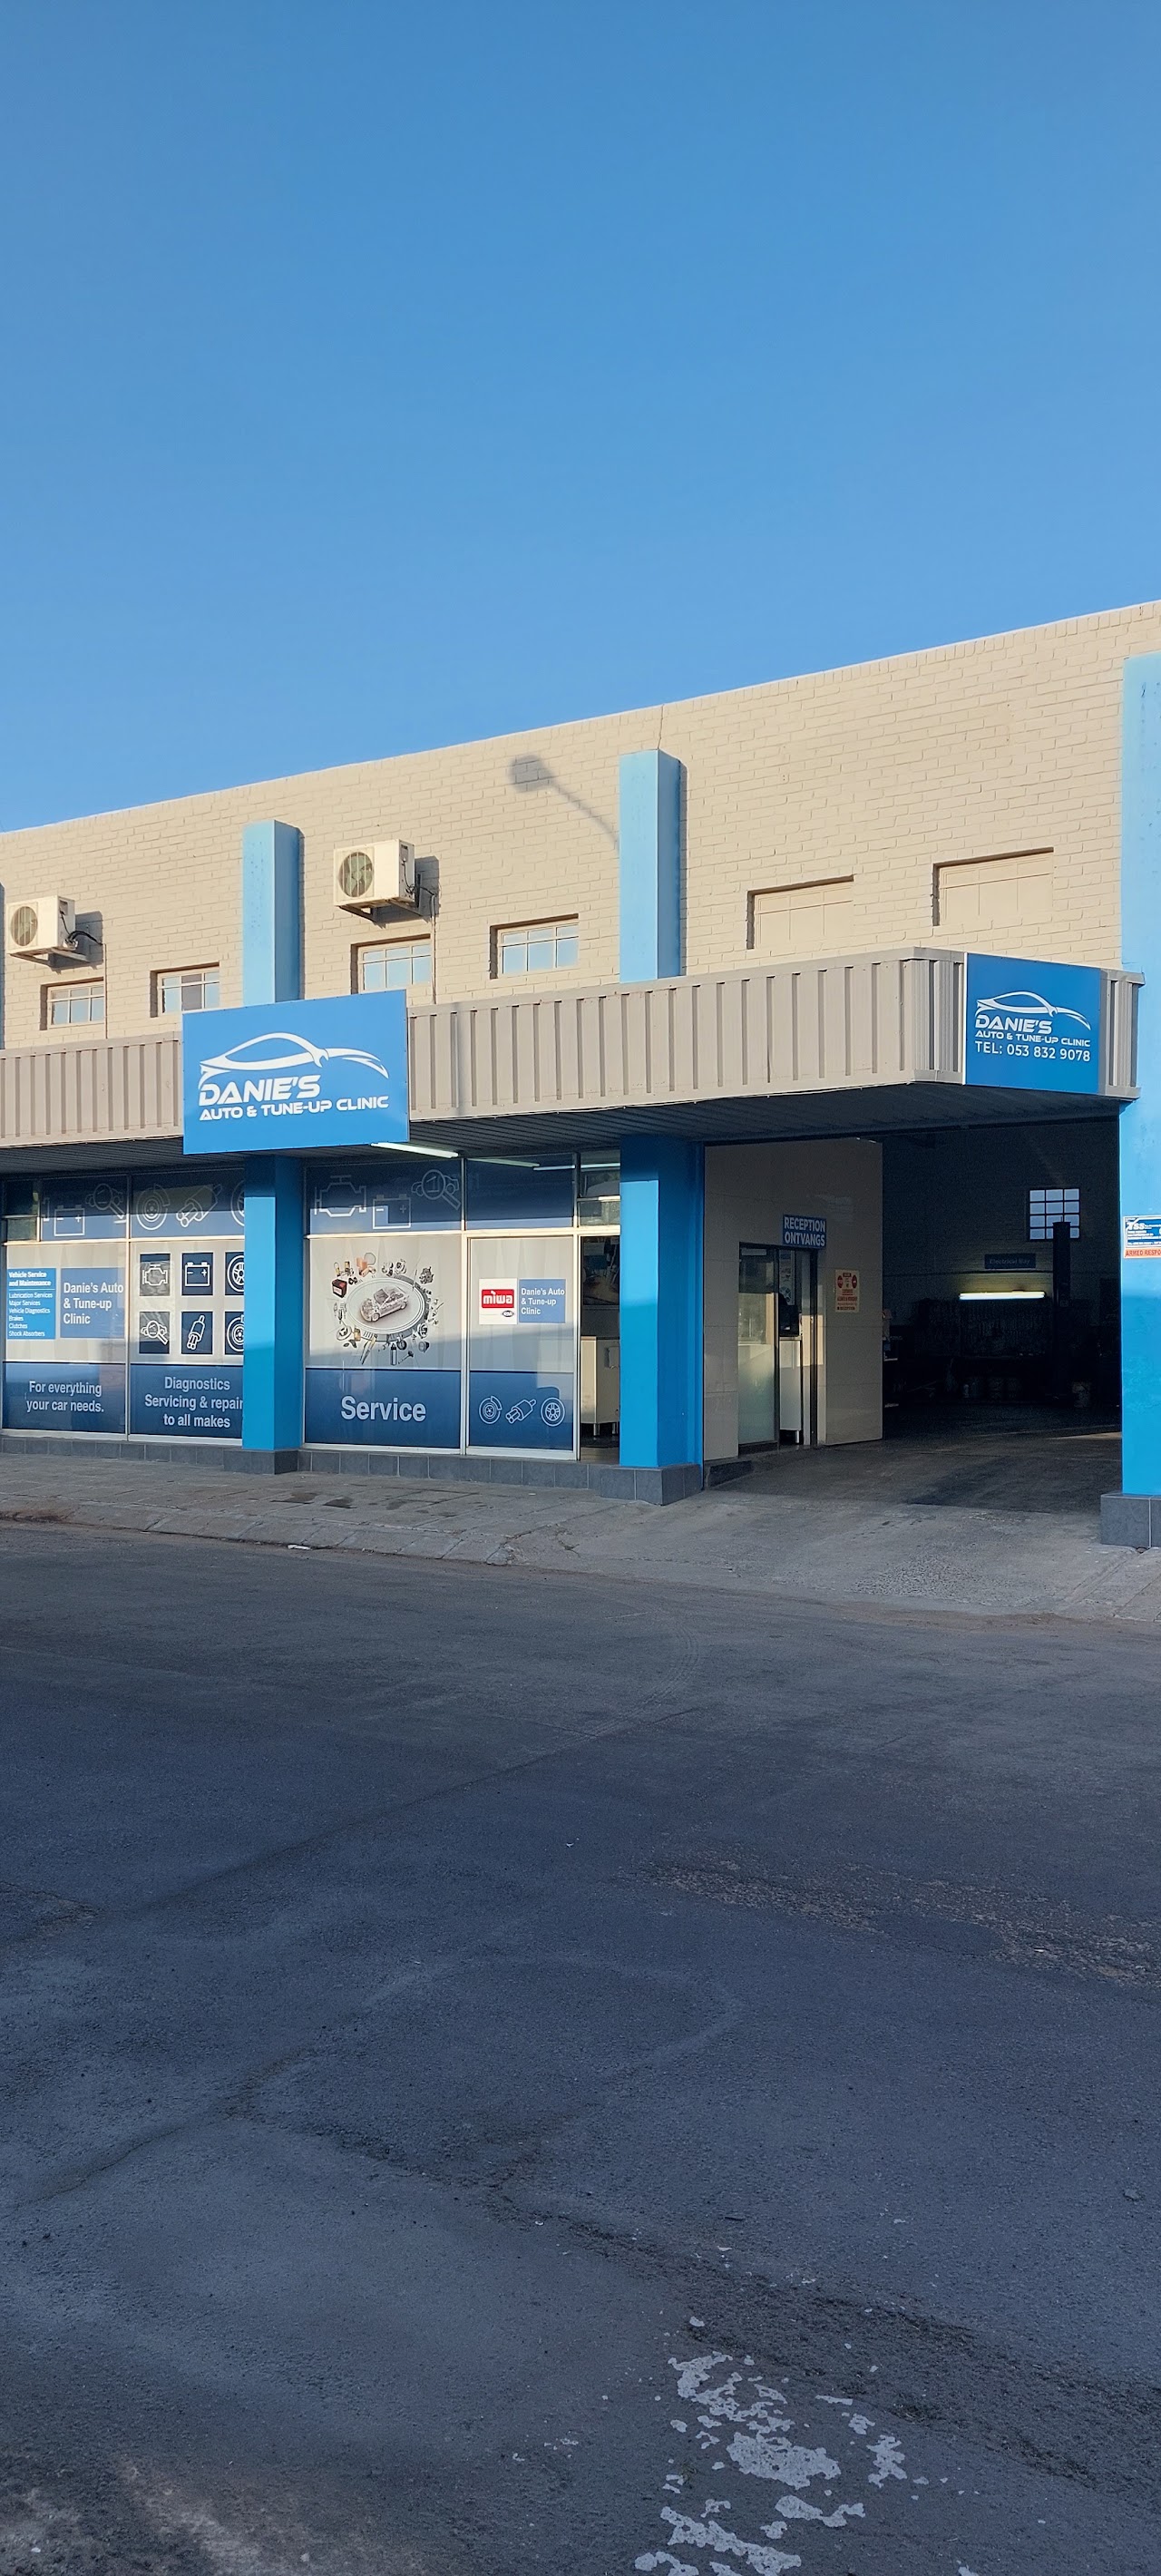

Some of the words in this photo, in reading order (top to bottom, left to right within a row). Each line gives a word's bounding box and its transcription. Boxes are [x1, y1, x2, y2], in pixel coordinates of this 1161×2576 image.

[975, 1015, 1052, 1034] DANIE'S
[975, 1030, 1004, 1039] AUTO
[1006, 1032, 1013, 1040] &
[1016, 1034, 1059, 1044] TUNE-UP
[1061, 1038, 1091, 1047] CLINIC
[975, 1041, 1002, 1054] TEL:
[1007, 1044, 1029, 1057] 053
[1033, 1047, 1056, 1059] 832
[1059, 1049, 1090, 1062] 9078
[199, 1075, 321, 1106] DANIE'S
[200, 1105, 243, 1121] AUTO
[247, 1105, 258, 1117] &
[261, 1099, 333, 1117] TUNE-UP
[336, 1096, 390, 1111] CLINIC
[784, 1216, 825, 1232] RECEPTION
[785, 1231, 824, 1246] ONTVANGS
[63, 1282, 98, 1293] Danie's
[100, 1282, 124, 1293] Auto
[521, 1288, 546, 1296] Danie's
[548, 1288, 565, 1296] Auto
[63, 1298, 71, 1309] &
[73, 1298, 112, 1312] Tune-up
[528, 1298, 557, 1306] Tune-up
[24, 1307, 51, 1315] Diagnostics
[63, 1312, 91, 1324] Clinic
[521, 1307, 541, 1315] Clinic
[29, 1381, 46, 1393] For
[48, 1381, 102, 1398] everything
[164, 1377, 230, 1391] Diagnostics
[26, 1400, 49, 1413] your
[51, 1401, 68, 1411] car
[70, 1400, 105, 1413] needs.
[144, 1394, 196, 1410] Servicing
[199, 1395, 209, 1408] &
[340, 1395, 426, 1422] Service
[163, 1414, 175, 1426] to
[177, 1414, 190, 1427] all
[193, 1414, 231, 1429] makes
